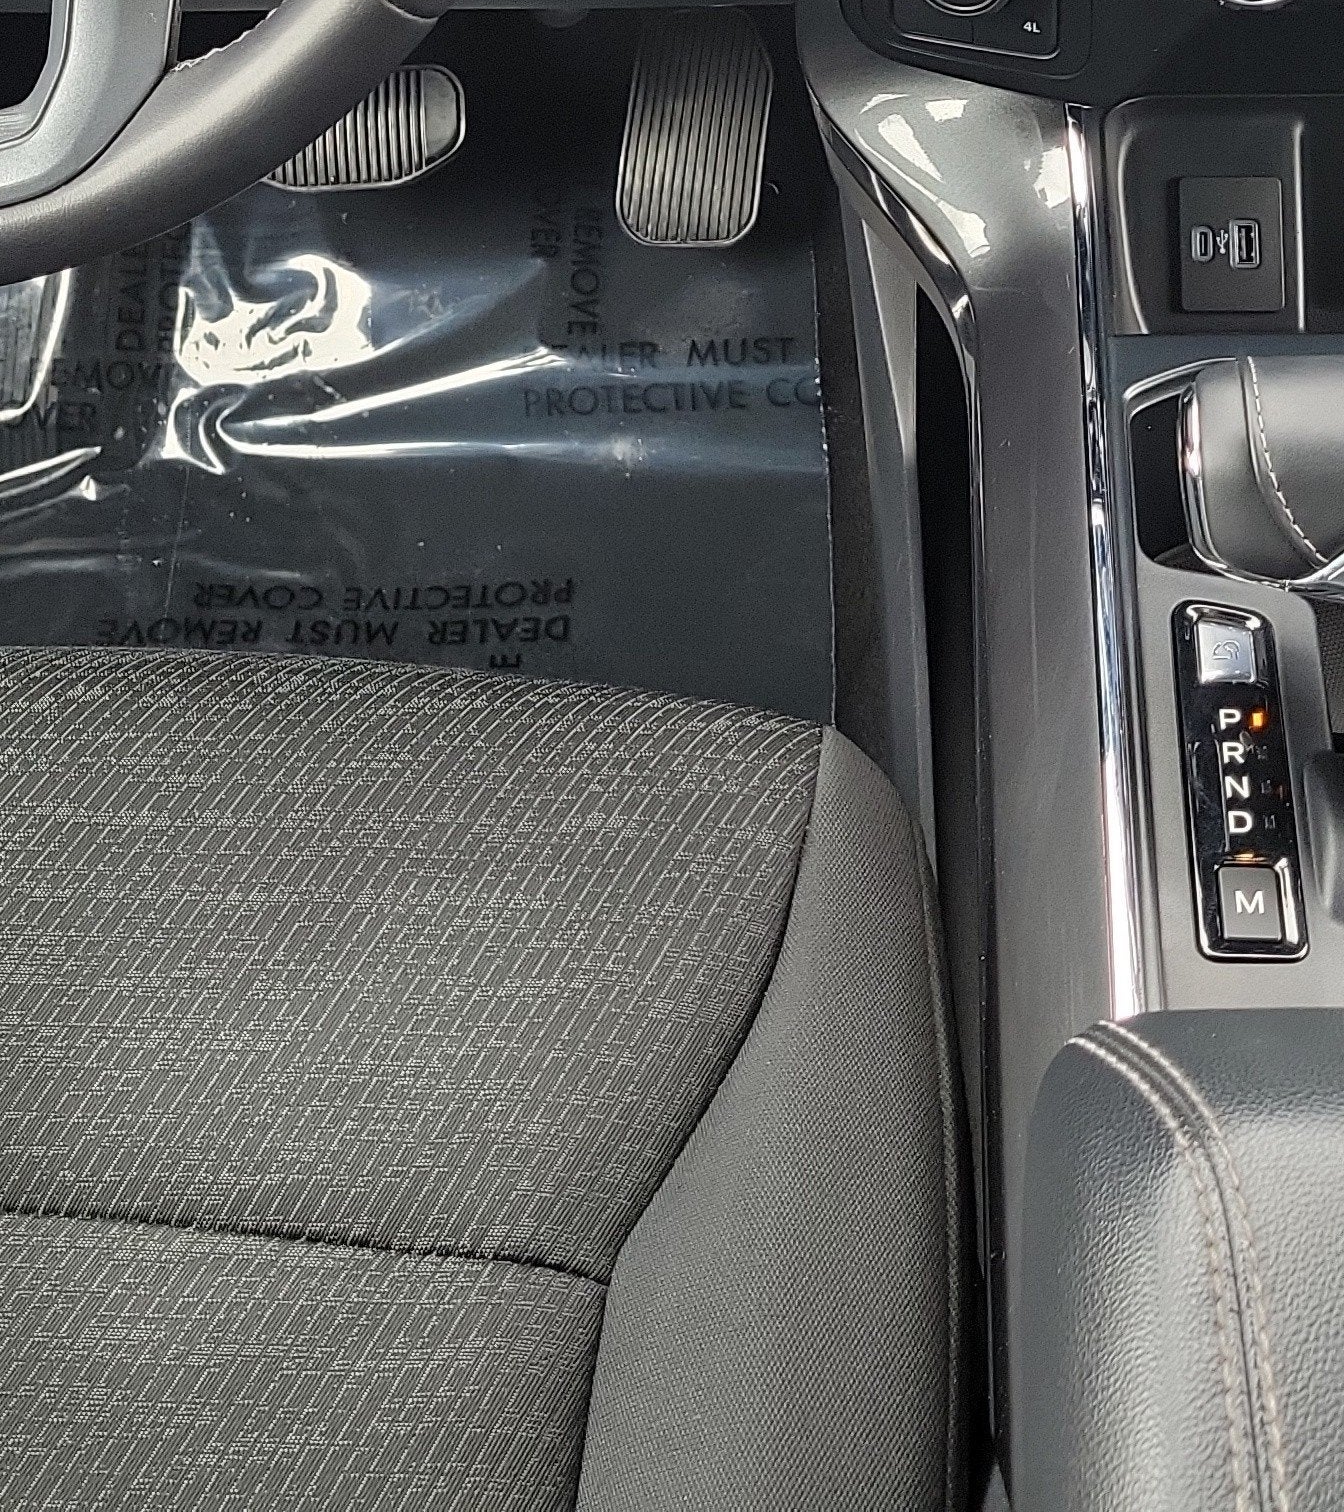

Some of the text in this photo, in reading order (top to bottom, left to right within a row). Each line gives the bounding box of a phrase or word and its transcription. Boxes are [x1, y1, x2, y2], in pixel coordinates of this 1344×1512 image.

[1022, 21, 1042, 34] 4L
[688, 336, 802, 369] MUST
[523, 380, 755, 420] PROTECTIVE
[191, 577, 578, 611] PROTECTIVE COVER
[96, 614, 573, 647] DEALER MUST REMOVE
[1218, 707, 1242, 731] P
[1222, 741, 1246, 764] R
[1224, 775, 1250, 799] N
[1228, 810, 1253, 834] D
[1233, 889, 1266, 915] M
